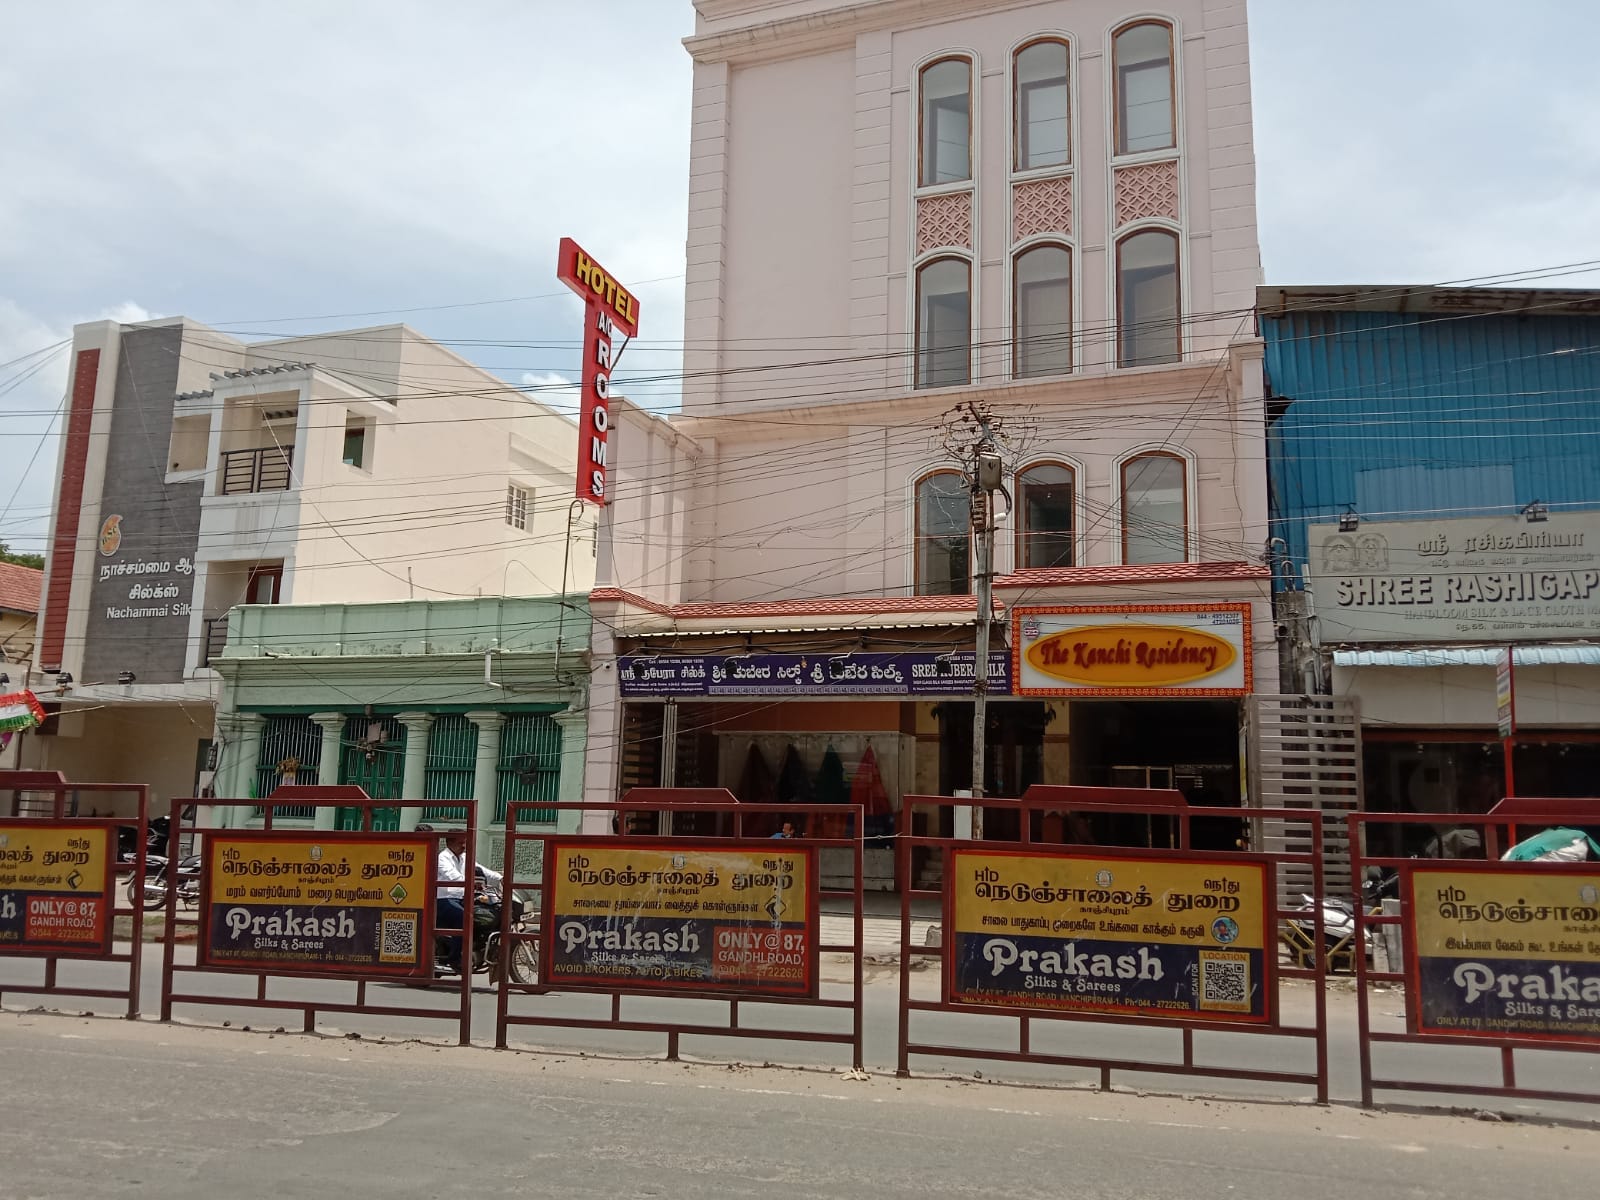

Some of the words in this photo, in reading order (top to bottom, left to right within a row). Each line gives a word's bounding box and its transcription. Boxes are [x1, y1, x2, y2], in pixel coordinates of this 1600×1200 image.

[577, 252, 635, 325] HOTEL
[596, 311, 612, 337] A/C
[591, 338, 611, 496] ROOMS
[175, 558, 197, 574] ஆ
[129, 583, 179, 600] சில்க்ஸ்
[1337, 576, 1433, 607] SHREE
[1445, 570, 1600, 604] RASHIGAP
[107, 604, 168, 618] Nachammai
[1471, 607, 1497, 618] SILK
[1545, 605, 1585, 616] CLOTH
[1041, 639, 1069, 665] The
[1073, 638, 1130, 669] Kanchi
[1135, 638, 1217, 671] Residency
[912, 664, 937, 677] SREE
[987, 663, 1006, 677] ILK
[43, 849, 89, 865] துறை
[222, 857, 351, 877] நெடுஞ்சாலைத்
[361, 863, 414, 879] துறை
[568, 865, 720, 888] நெடுஞ்சாலைத்
[732, 871, 794, 891] துறை
[226, 885, 246, 898] மரம்
[249, 885, 301, 899] வளர்ப்போம்
[308, 888, 331, 902] மழை
[335, 887, 383, 903] பெறுவோம்
[975, 881, 1153, 908] நெடுஞ்சாலைத்
[1168, 894, 1240, 913] துறை
[30, 901, 64, 915] ONLY
[65, 901, 77, 915] @
[80, 902, 96, 919] 87,
[384, 912, 415, 920] LOCATION
[1080, 905, 1130, 916] காஞ்சிபுரம்
[30, 917, 65, 926] GANDHI
[66, 917, 96, 929] ROAD,
[225, 907, 356, 940] Prakash
[982, 916, 1008, 927] சாலை
[1011, 916, 1050, 931] பாதுகாப்பு
[1142, 921, 1176, 937] காக்கும்
[254, 937, 278, 949] Silks
[280, 939, 288, 950] &
[291, 938, 324, 950] Sarees
[559, 921, 700, 953] Prakash
[718, 931, 761, 949] ONLY
[764, 933, 782, 950] @
[783, 934, 805, 953] 87,
[591, 952, 617, 963] Silks
[718, 951, 765, 964] GANDHI
[766, 952, 804, 967] ROAD,
[982, 938, 1165, 981] Prakash
[1202, 952, 1247, 961] LOCATION
[554, 964, 582, 974] AVOID
[585, 964, 633, 976] BROKERS,
[636, 966, 661, 977] AUTO
[674, 967, 704, 978] BIKES
[1024, 975, 1057, 989] Silks
[1062, 978, 1072, 992] &
[1076, 979, 1121, 993] Sarees
[1138, 999, 1151, 1007] 044
[1505, 1001, 1544, 1016] Silks
[1550, 1005, 1562, 1019] &
[1436, 1016, 1458, 1026] ONLY
